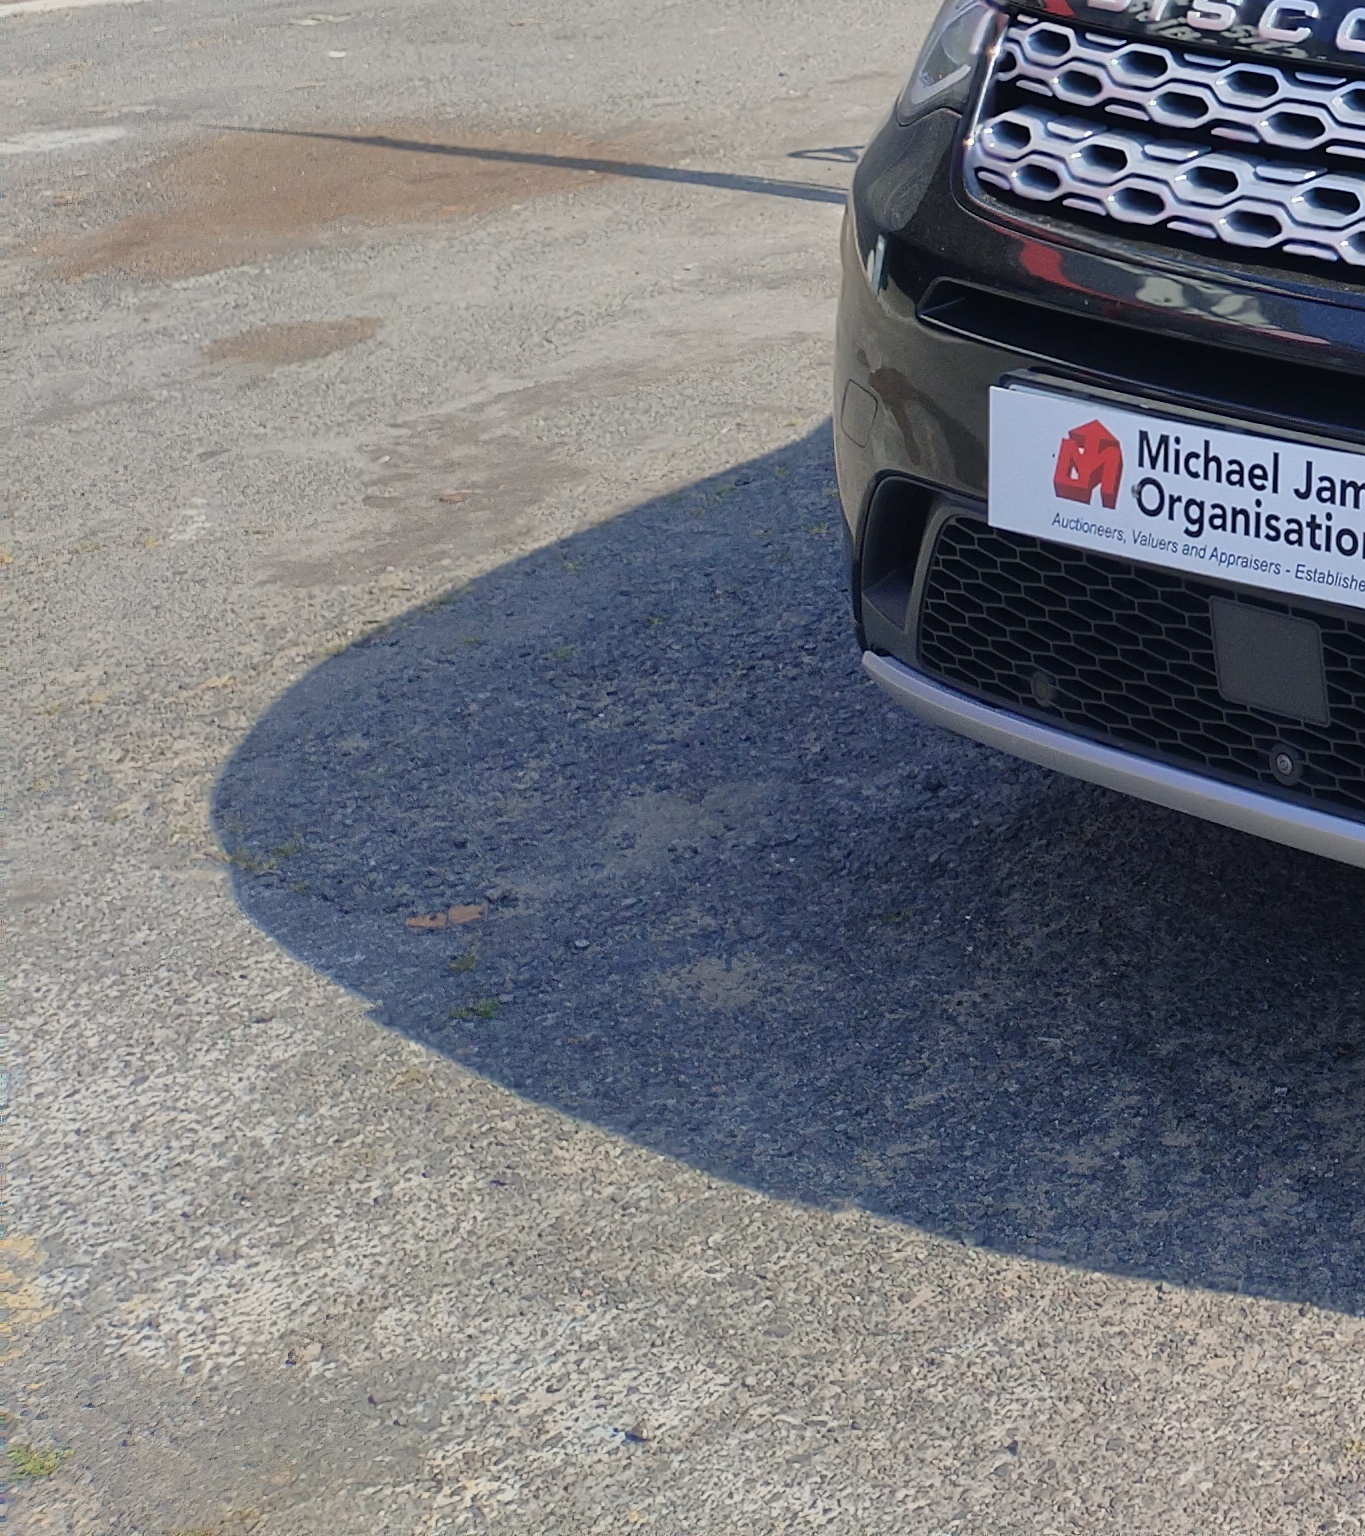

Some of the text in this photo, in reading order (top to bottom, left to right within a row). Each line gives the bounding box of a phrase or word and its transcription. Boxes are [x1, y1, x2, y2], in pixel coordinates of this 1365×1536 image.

[1137, 428, 1280, 495] Michael
[1051, 512, 1127, 544] Auctioneers,
[1131, 528, 1179, 554] Valuers
[1181, 543, 1208, 560] and
[1208, 546, 1283, 577] Appraisers
